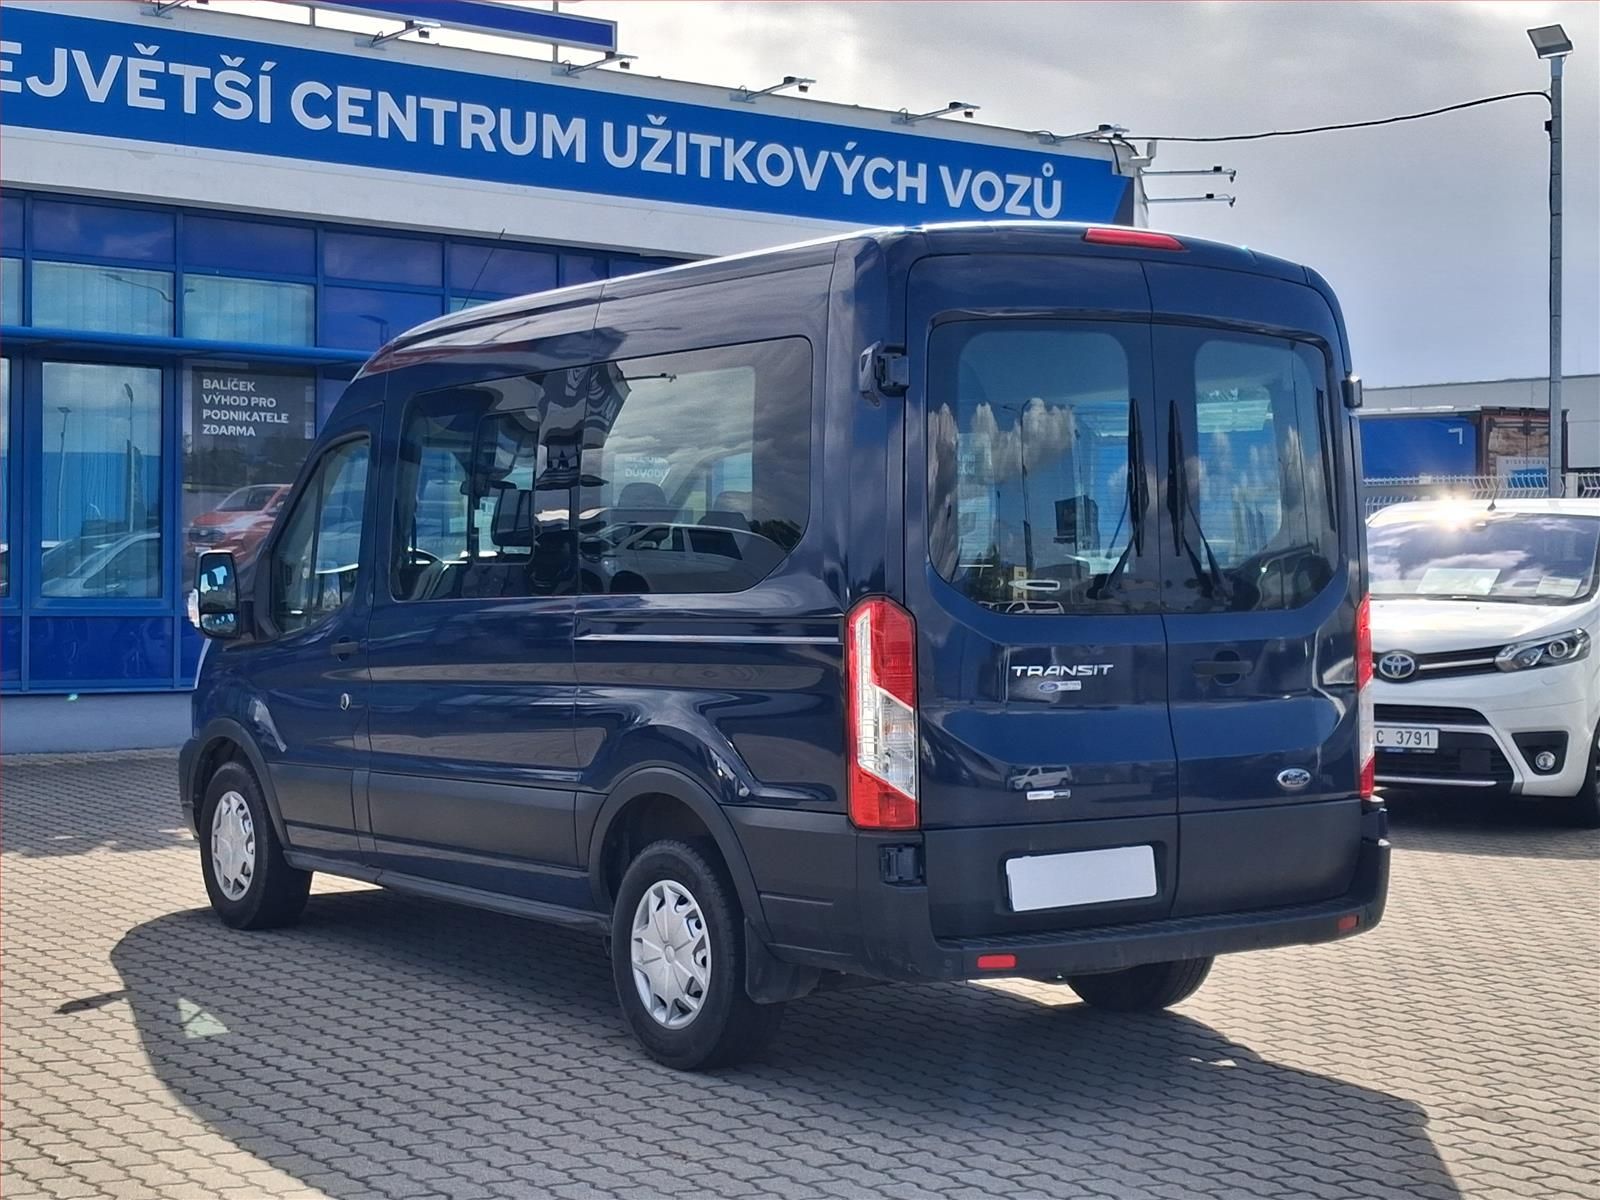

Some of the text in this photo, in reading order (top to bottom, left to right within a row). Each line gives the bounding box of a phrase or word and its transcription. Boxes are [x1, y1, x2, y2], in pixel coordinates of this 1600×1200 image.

[290, 80, 587, 164] CENTRUM
[602, 114, 928, 204] UŽITKOVÝCH
[940, 161, 1063, 218] VOZŮ
[202, 377, 256, 392] BALÍČEK
[202, 392, 277, 408] VÝHOD PRO
[202, 409, 289, 424] PODNIKATELE
[202, 424, 256, 437] ZDARMA
[1011, 664, 1114, 677] TRANSIT
[1395, 730, 1430, 746] 3791
